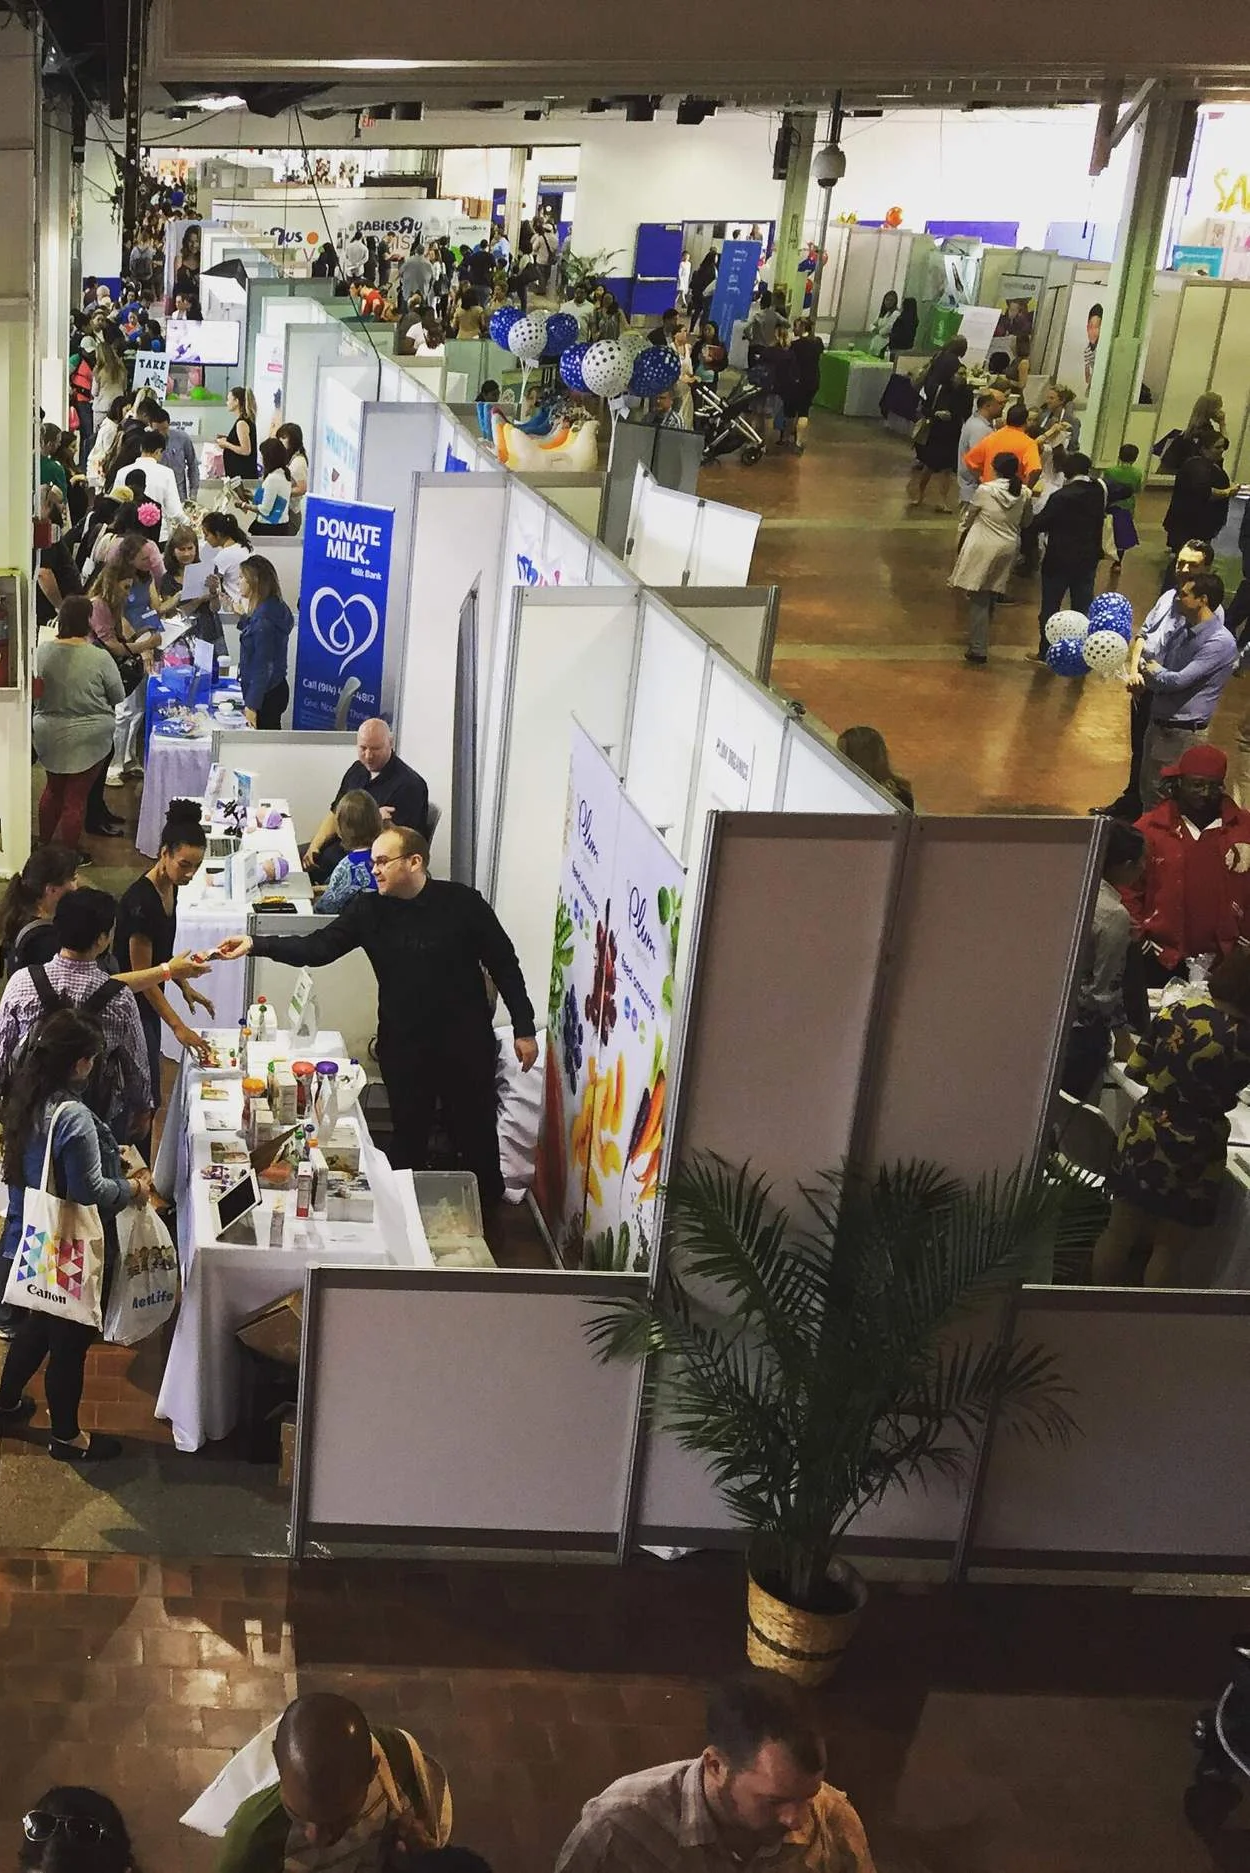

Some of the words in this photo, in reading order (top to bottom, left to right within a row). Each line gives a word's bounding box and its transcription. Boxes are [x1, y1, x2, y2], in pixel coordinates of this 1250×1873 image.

[138, 358, 167, 371] TAKE
[316, 516, 382, 548] DONATE
[326, 538, 371, 566] MILK.
[350, 566, 365, 578] Milk
[365, 568, 382, 581] Bank
[302, 678, 317, 691] Call
[578, 799, 600, 864] Plum
[628, 886, 657, 960] Plum
[27, 1283, 67, 1305] Canon
